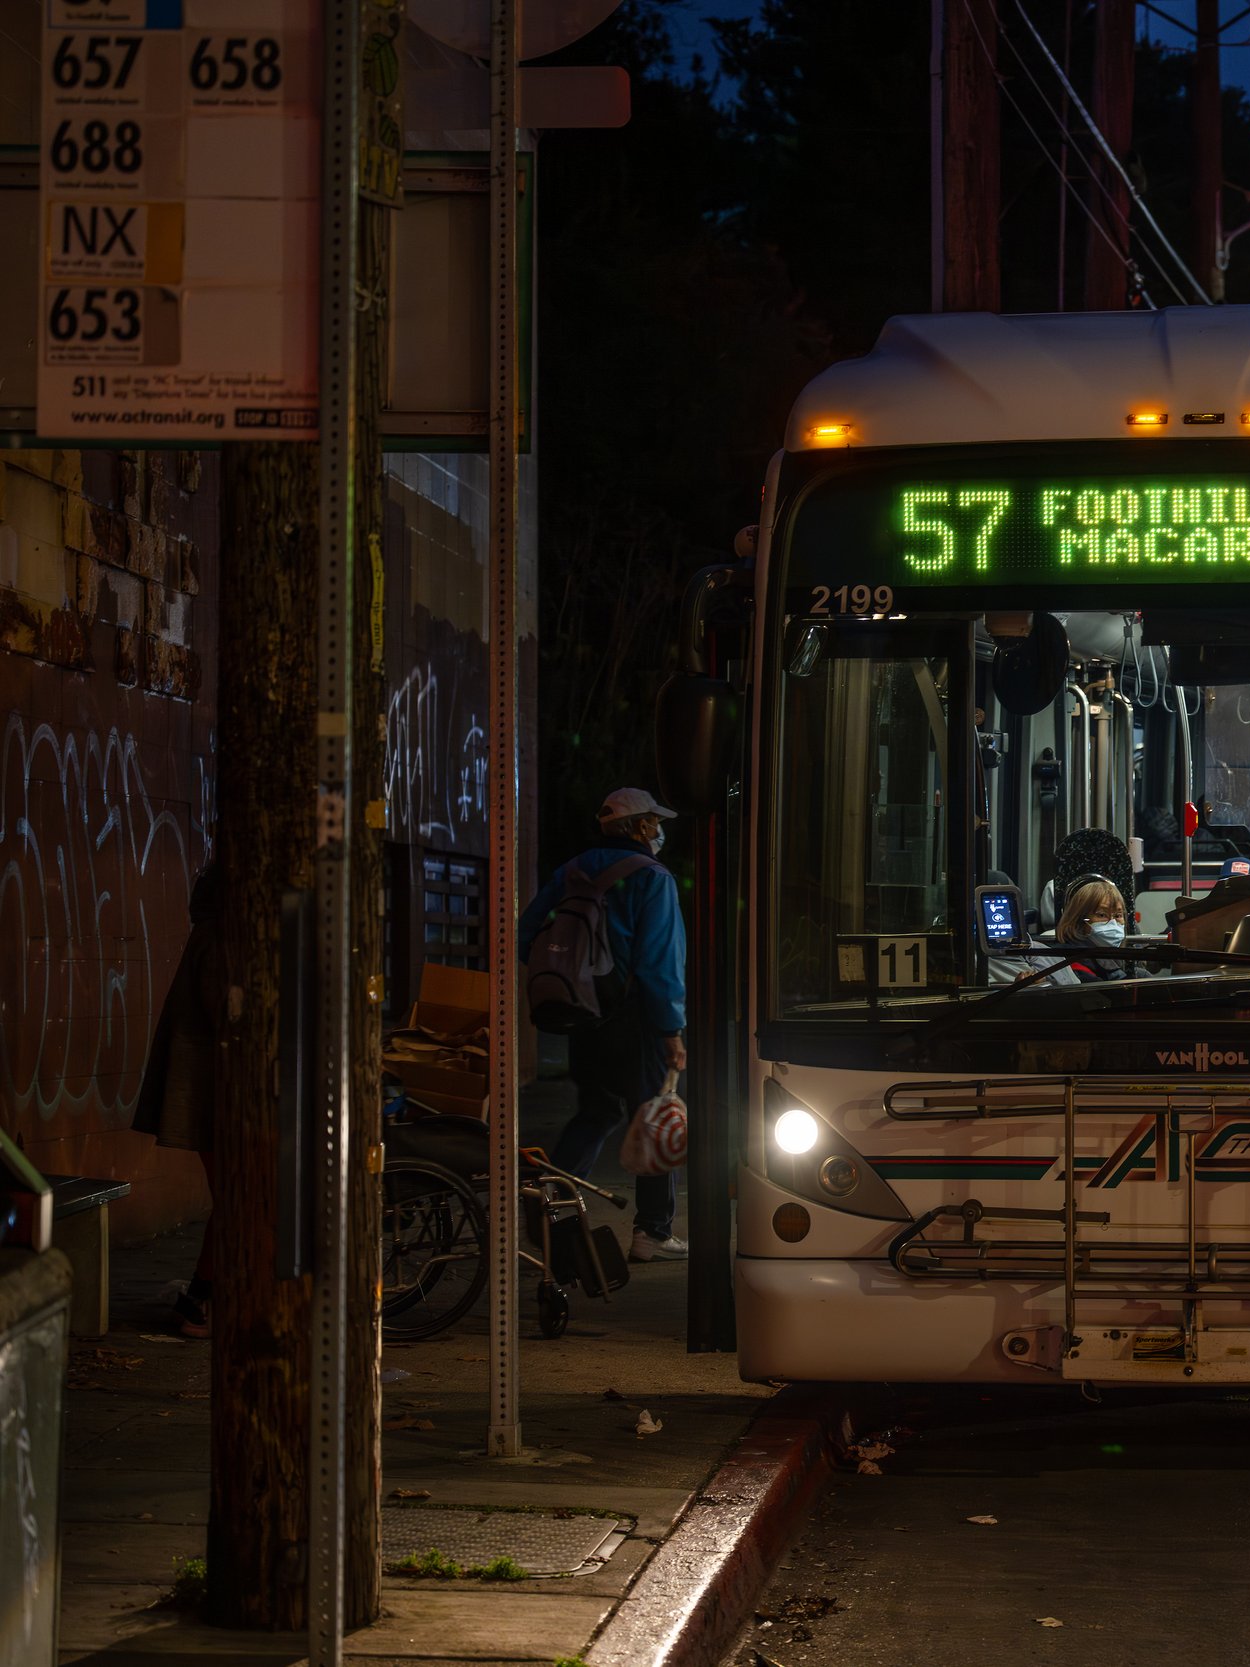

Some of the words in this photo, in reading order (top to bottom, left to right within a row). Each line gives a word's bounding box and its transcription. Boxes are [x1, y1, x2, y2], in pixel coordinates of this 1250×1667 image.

[53, 36, 143, 90] 657
[190, 37, 282, 91] 658
[51, 119, 142, 173] 688
[62, 205, 137, 255] NX
[50, 289, 141, 342] 653
[72, 375, 107, 397] 511
[71, 407, 226, 428] www.actransit.org
[902, 489, 1010, 571] 57
[809, 584, 894, 614] 2199
[880, 942, 920, 983] 11
